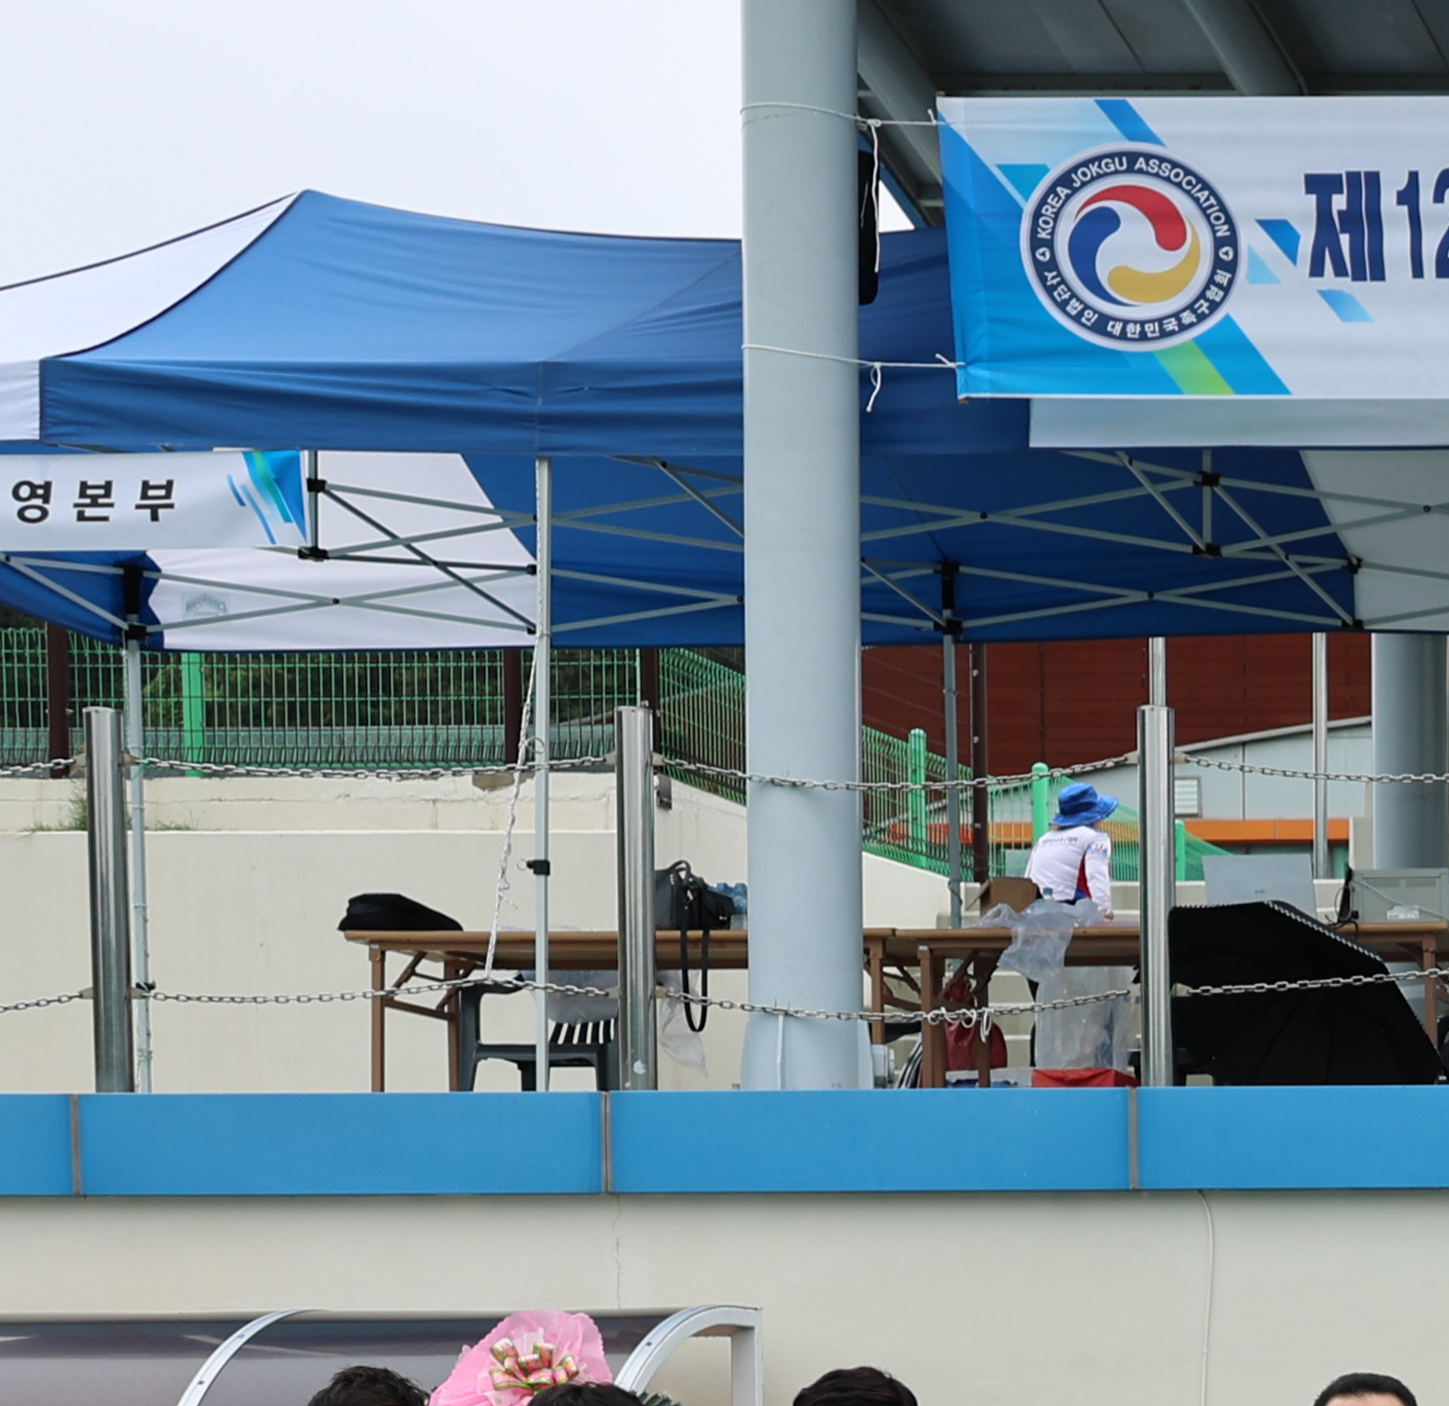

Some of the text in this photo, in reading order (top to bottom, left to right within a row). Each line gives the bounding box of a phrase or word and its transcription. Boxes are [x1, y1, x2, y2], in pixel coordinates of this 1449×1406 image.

[1037, 156, 1231, 239] KOREA JOKGU ASSOCIATION
[1044, 269, 1232, 339] 사단법인 대한민국족구협회
